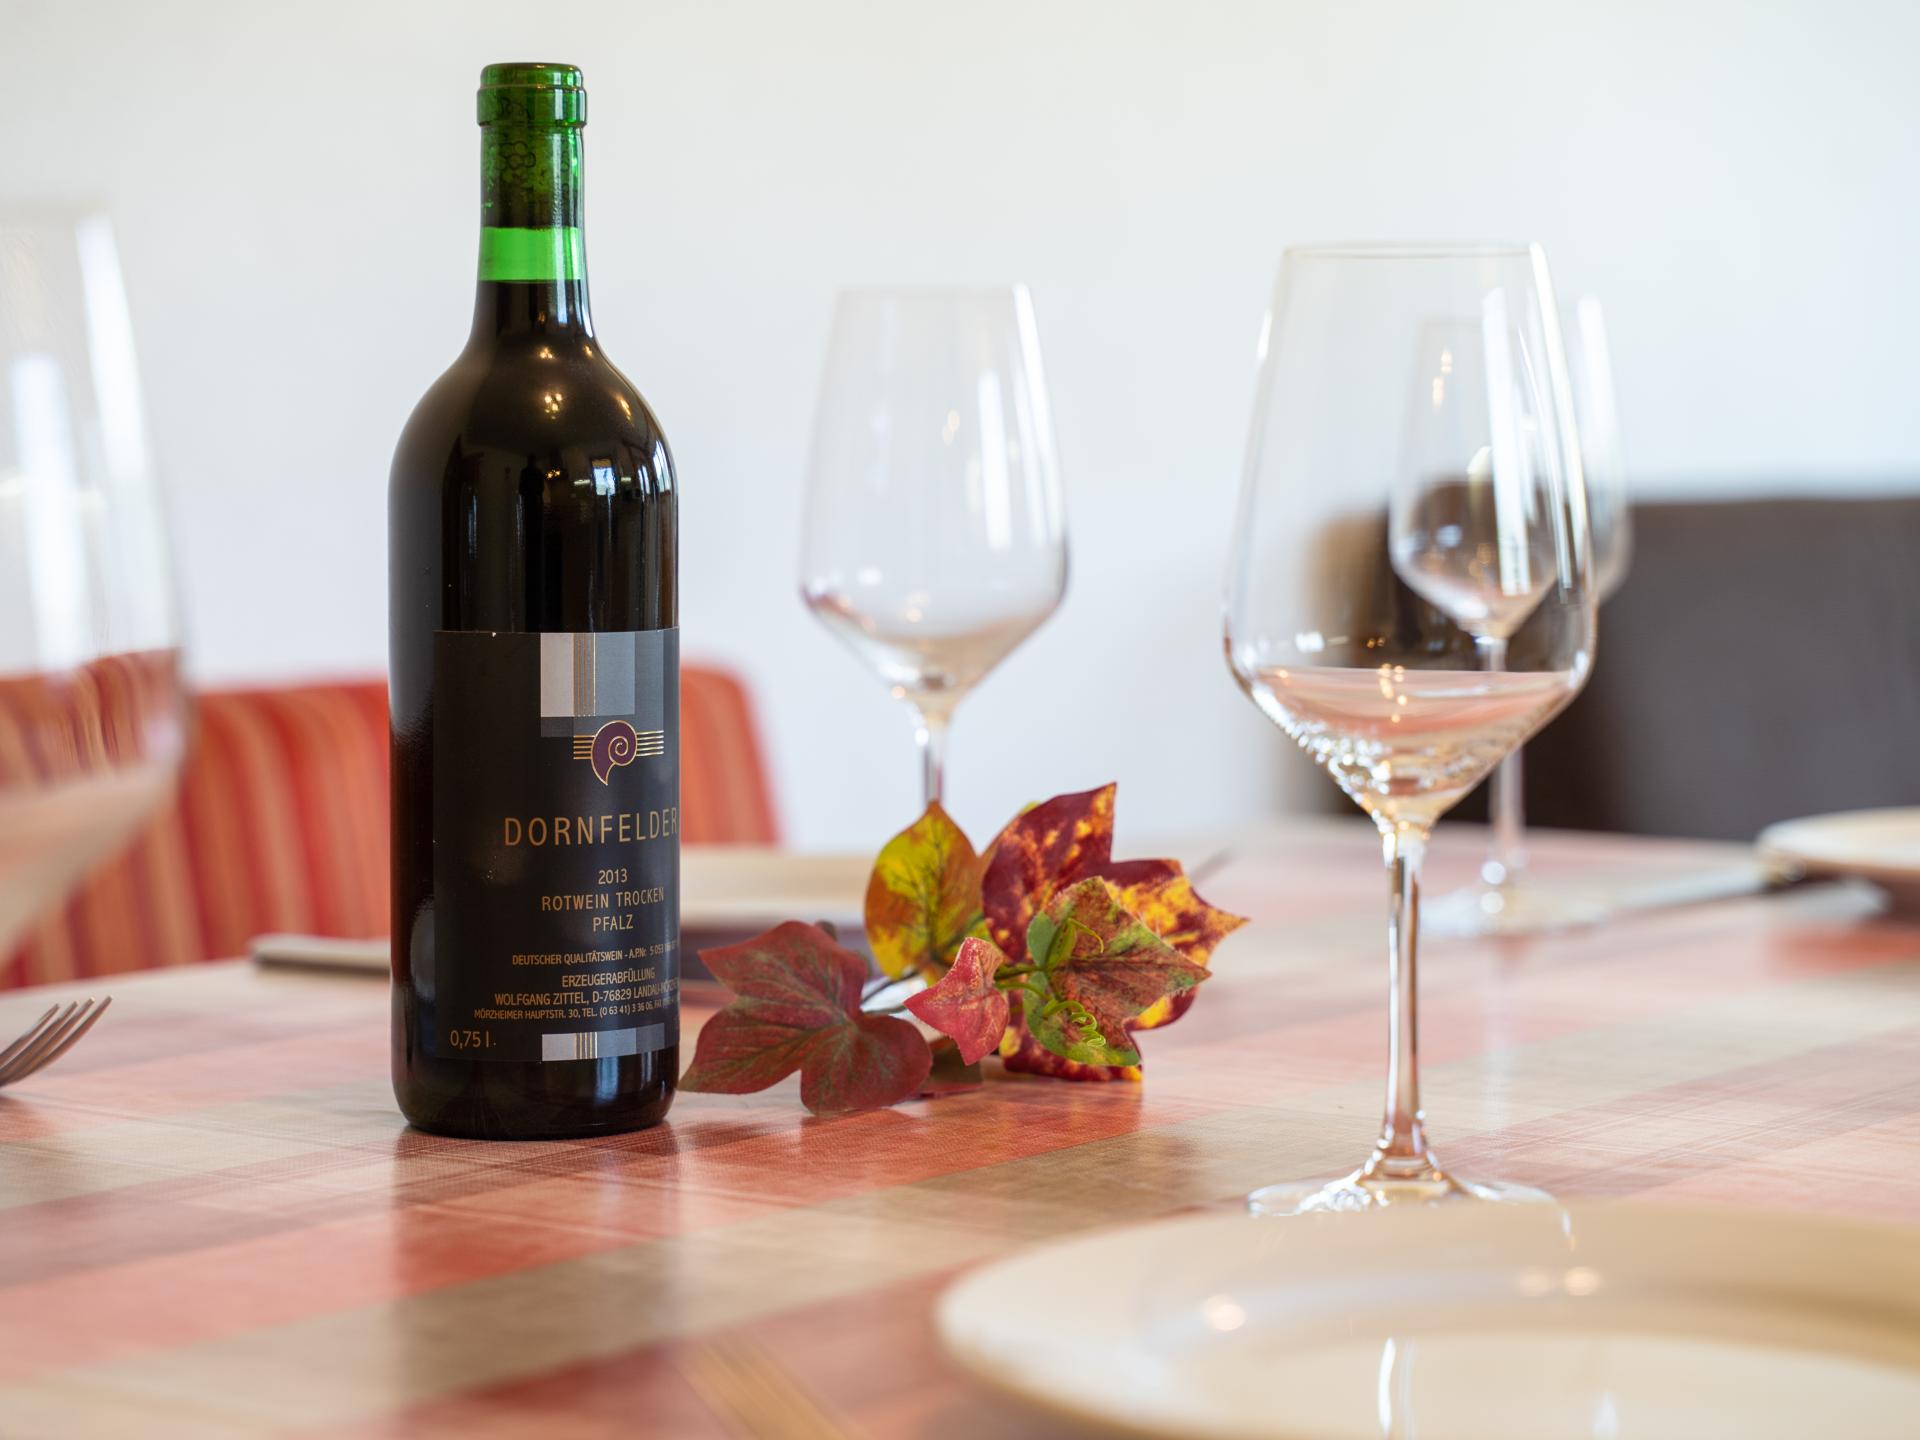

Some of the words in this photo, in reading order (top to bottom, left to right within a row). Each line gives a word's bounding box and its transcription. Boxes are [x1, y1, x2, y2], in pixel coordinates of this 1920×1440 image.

[504, 807, 678, 846] DORNFELDER
[598, 868, 628, 885] 2013
[541, 893, 609, 912] ROTWEIN
[616, 887, 665, 907] TROCKEN
[593, 914, 634, 932] PFALZ
[512, 954, 562, 966] DEUTSCHER
[564, 950, 623, 966] QUALITÄTSWEIN
[562, 967, 656, 988] ERZEUGERABFÜLLUNG
[495, 993, 551, 1006] WOLFGANG
[553, 991, 590, 1005] ZITTEL,
[592, 988, 632, 1003] D-76829
[474, 1008, 523, 1019] MÖRZHEIMER
[525, 1009, 567, 1019] HAUPTSTR.
[582, 1007, 598, 1017] TEL.
[608, 1005, 618, 1015] 63
[450, 1029, 481, 1049] 0,75
